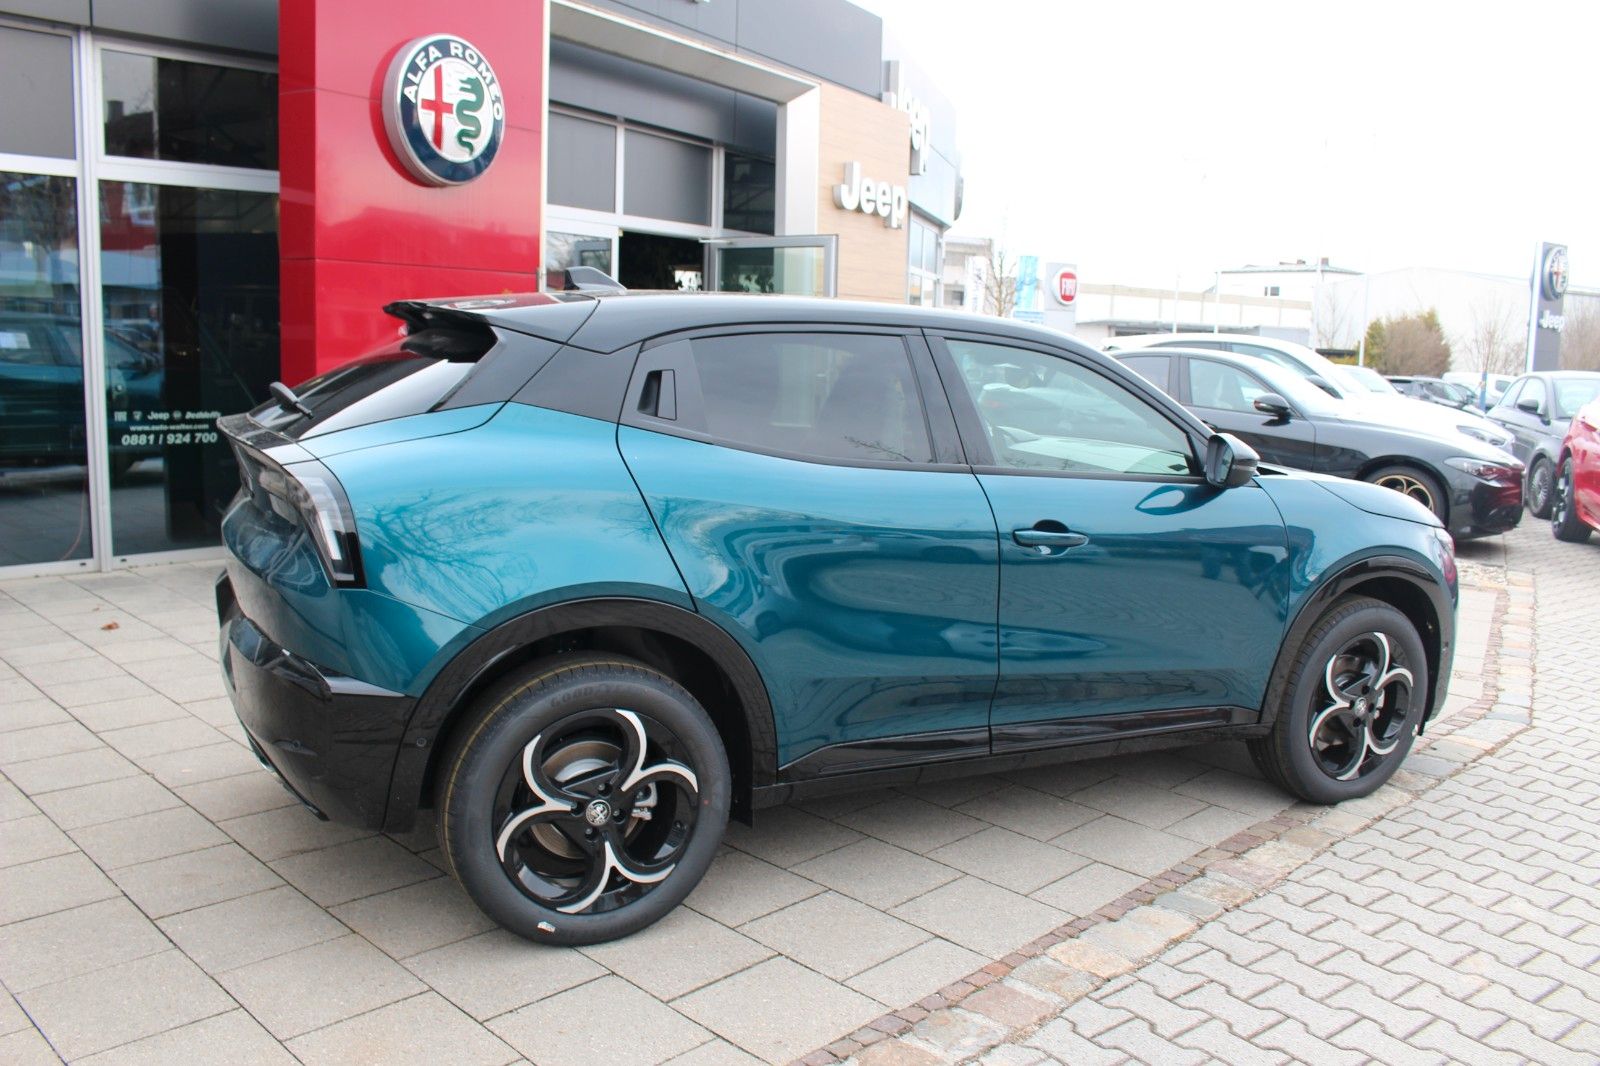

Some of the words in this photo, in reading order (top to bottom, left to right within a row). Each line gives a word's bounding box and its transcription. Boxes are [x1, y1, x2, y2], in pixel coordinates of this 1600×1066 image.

[404, 45, 442, 104] ALFA
[450, 41, 503, 121] ROMEO
[834, 161, 907, 229] Jeep
[1540, 309, 1566, 332] Jeep
[147, 411, 170, 420] Jeep
[121, 434, 155, 445] 0881
[166, 433, 191, 444] 924
[194, 432, 218, 443] 700
